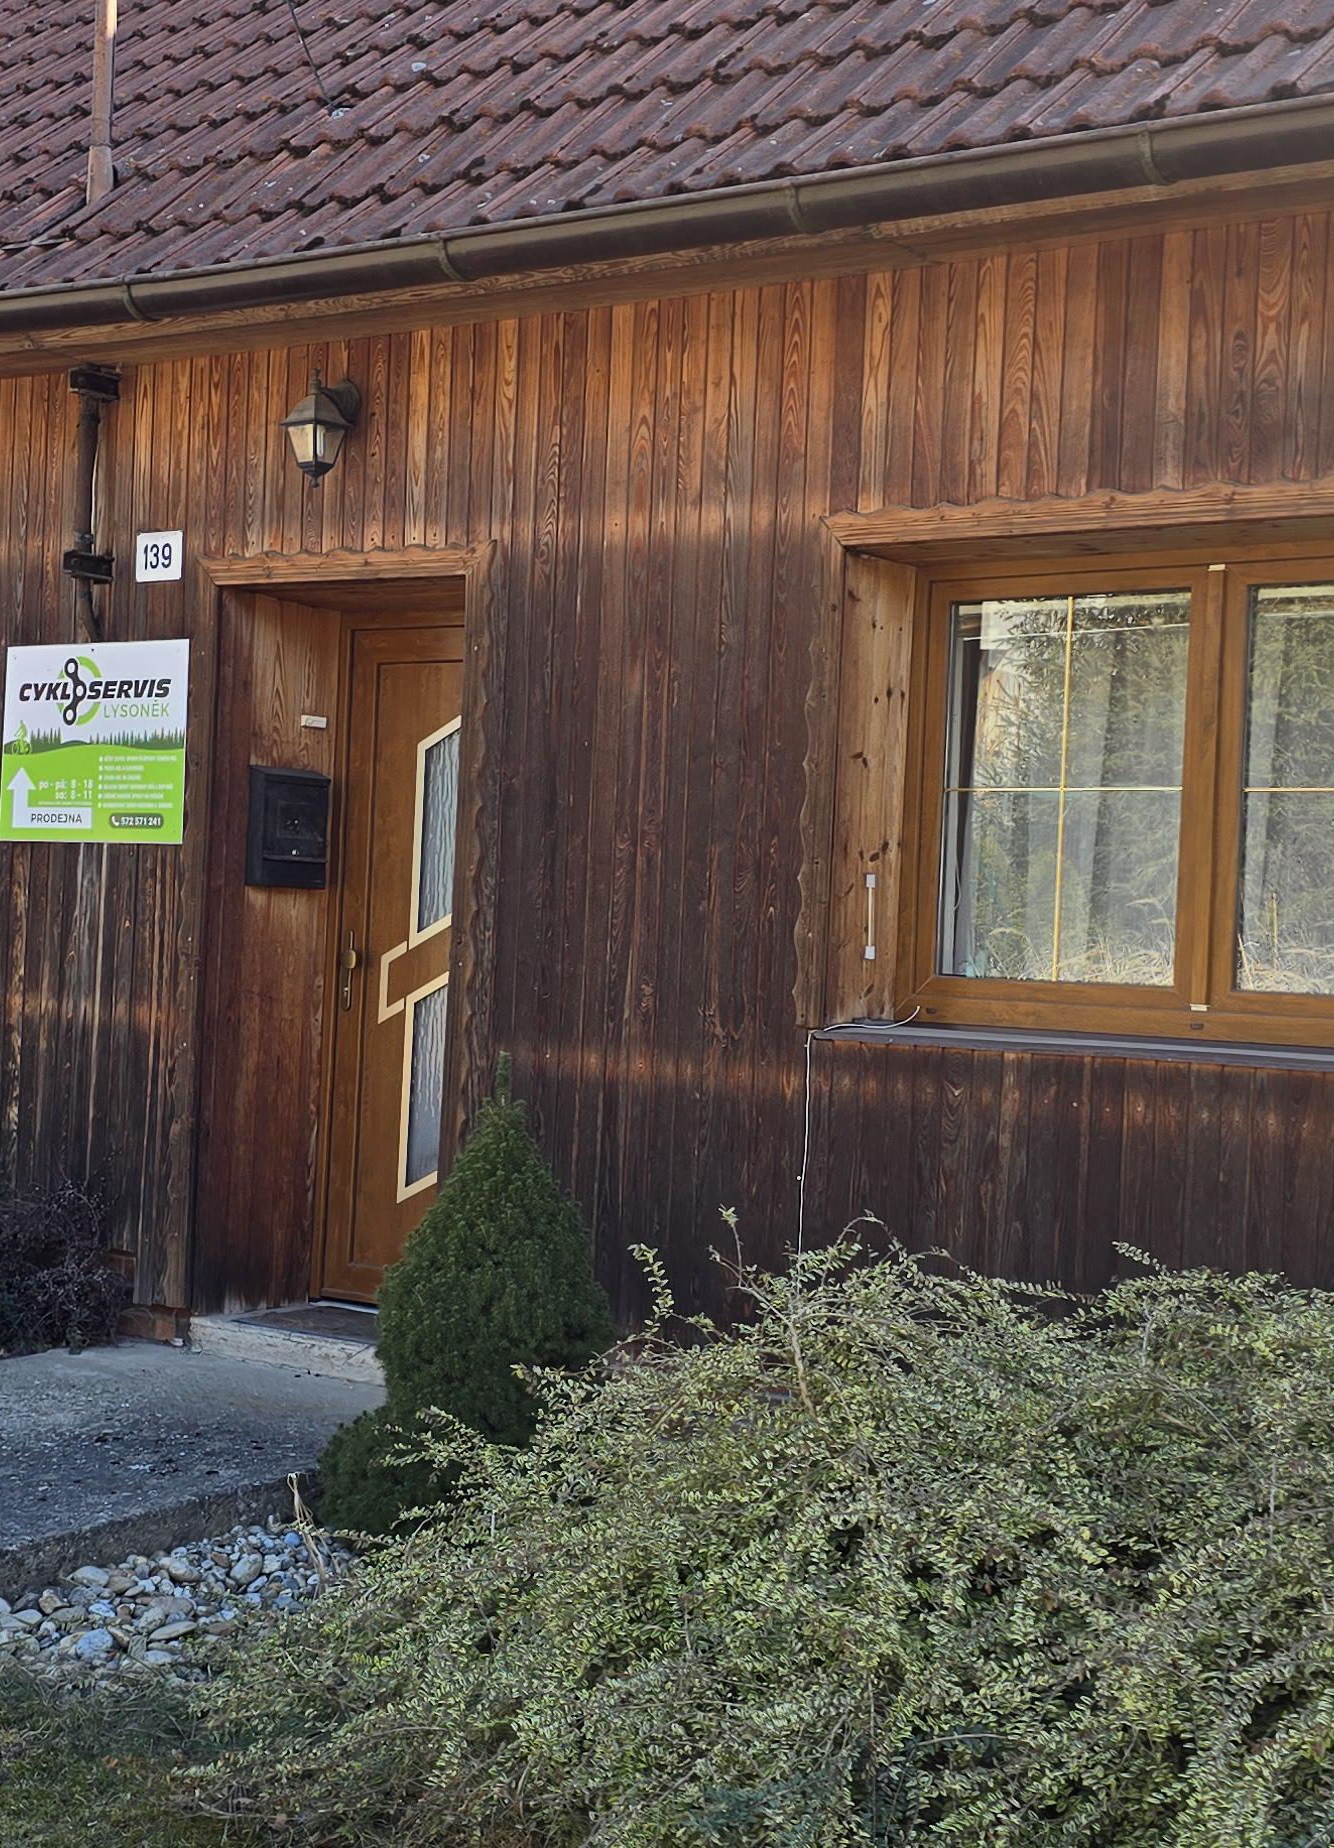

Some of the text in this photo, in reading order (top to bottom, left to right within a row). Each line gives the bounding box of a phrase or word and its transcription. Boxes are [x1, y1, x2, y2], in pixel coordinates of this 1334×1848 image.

[144, 542, 172, 570] 139
[19, 678, 172, 702] CYKLOSERVIS
[31, 813, 83, 824] PRODEJNA
